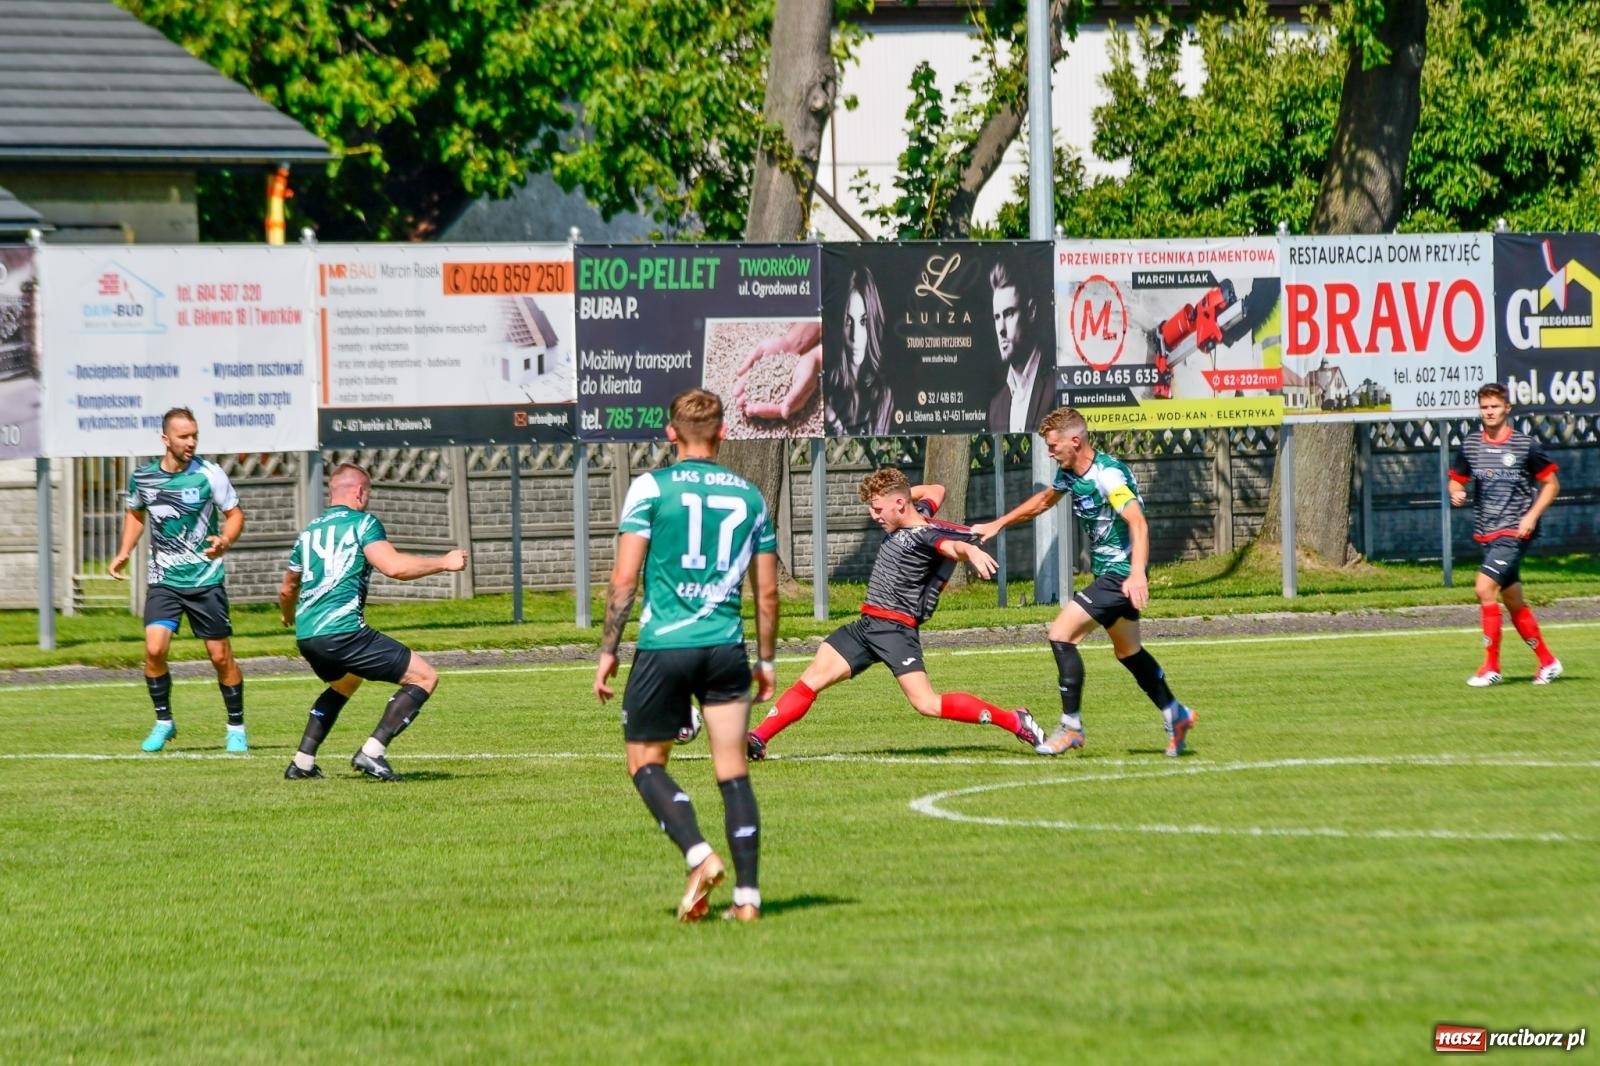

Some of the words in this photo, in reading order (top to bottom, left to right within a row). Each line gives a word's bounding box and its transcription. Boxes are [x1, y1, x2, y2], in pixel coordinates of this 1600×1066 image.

[1060, 252, 1133, 266] PRZEWIERTY
[1138, 250, 1194, 266] TECHNIKĄ
[1198, 248, 1275, 265] DIAMENTOWĄ
[1289, 246, 1383, 265] RESTAURACJA
[1388, 244, 1421, 263] DOM
[1426, 240, 1481, 266] PRZYJĘĆ
[328, 263, 346, 279] MR
[349, 263, 377, 279] BAU
[380, 263, 411, 279] Marcin
[413, 261, 441, 279] Rusek
[470, 264, 499, 293] 666
[503, 264, 532, 292] 859
[536, 263, 566, 292] 250
[579, 257, 720, 290] EKO-PELLET
[738, 254, 811, 277] TWORKÓW
[1138, 273, 1175, 285] MARCIN
[1177, 272, 1209, 284] LASAK
[197, 284, 216, 301] 604
[220, 284, 238, 301] 507
[242, 284, 262, 301] 320
[738, 282, 750, 296] ul.
[752, 281, 797, 298] Ogrodowa
[799, 282, 811, 295] 61
[194, 307, 233, 326] Główna
[255, 306, 302, 325] Tworków
[580, 297, 624, 319] BUBA
[626, 297, 640, 319] P.
[1285, 278, 1485, 355] BRAVO
[906, 311, 972, 324] LUIZA
[907, 336, 925, 348] STUDIO
[925, 336, 941, 348] SZTUKI
[942, 335, 972, 348] FRYZJERSKIEJ
[213, 361, 255, 379] Wynajem
[257, 360, 304, 377] rusztowań
[581, 350, 631, 373] Możliwy
[635, 351, 692, 372] transport
[76, 364, 130, 379] Docieplenia
[133, 362, 180, 379] budynków
[1073, 370, 1101, 385] 608
[1105, 369, 1131, 384] 465
[1135, 368, 1159, 384] 635
[1394, 367, 1411, 383] tel.
[1416, 367, 1436, 383] 602
[1440, 366, 1460, 381] 744
[1464, 366, 1484, 381] 173
[581, 375, 598, 395] do
[600, 375, 641, 395] klienta
[1508, 368, 1546, 405] tel.
[1550, 370, 1596, 405] 665
[213, 391, 256, 408] Wynajem
[257, 390, 292, 410] sprzętu
[928, 391, 936, 404] 32
[950, 391, 956, 404] 61
[957, 391, 964, 404] 21
[1074, 392, 1126, 403] marcinlasak
[1416, 391, 1436, 407] 606
[1440, 390, 1460, 406] 270
[1464, 390, 1479, 405] 89
[78, 414, 139, 431] wykończenia
[215, 412, 276, 428] budowlanego
[581, 408, 602, 430] tel.
[605, 408, 634, 430] 785
[637, 407, 663, 429] 742
[905, 410, 913, 422] ul.
[914, 409, 934, 422] Główna
[962, 408, 987, 421] Tworków
[1083, 413, 1147, 423] KUPERACJA
[1156, 410, 1207, 421] WOD-KAN
[1217, 408, 1275, 419] ELEKTRYKA
[672, 470, 700, 483] LKS
[681, 493, 747, 571] 17
[301, 525, 336, 583] 14
